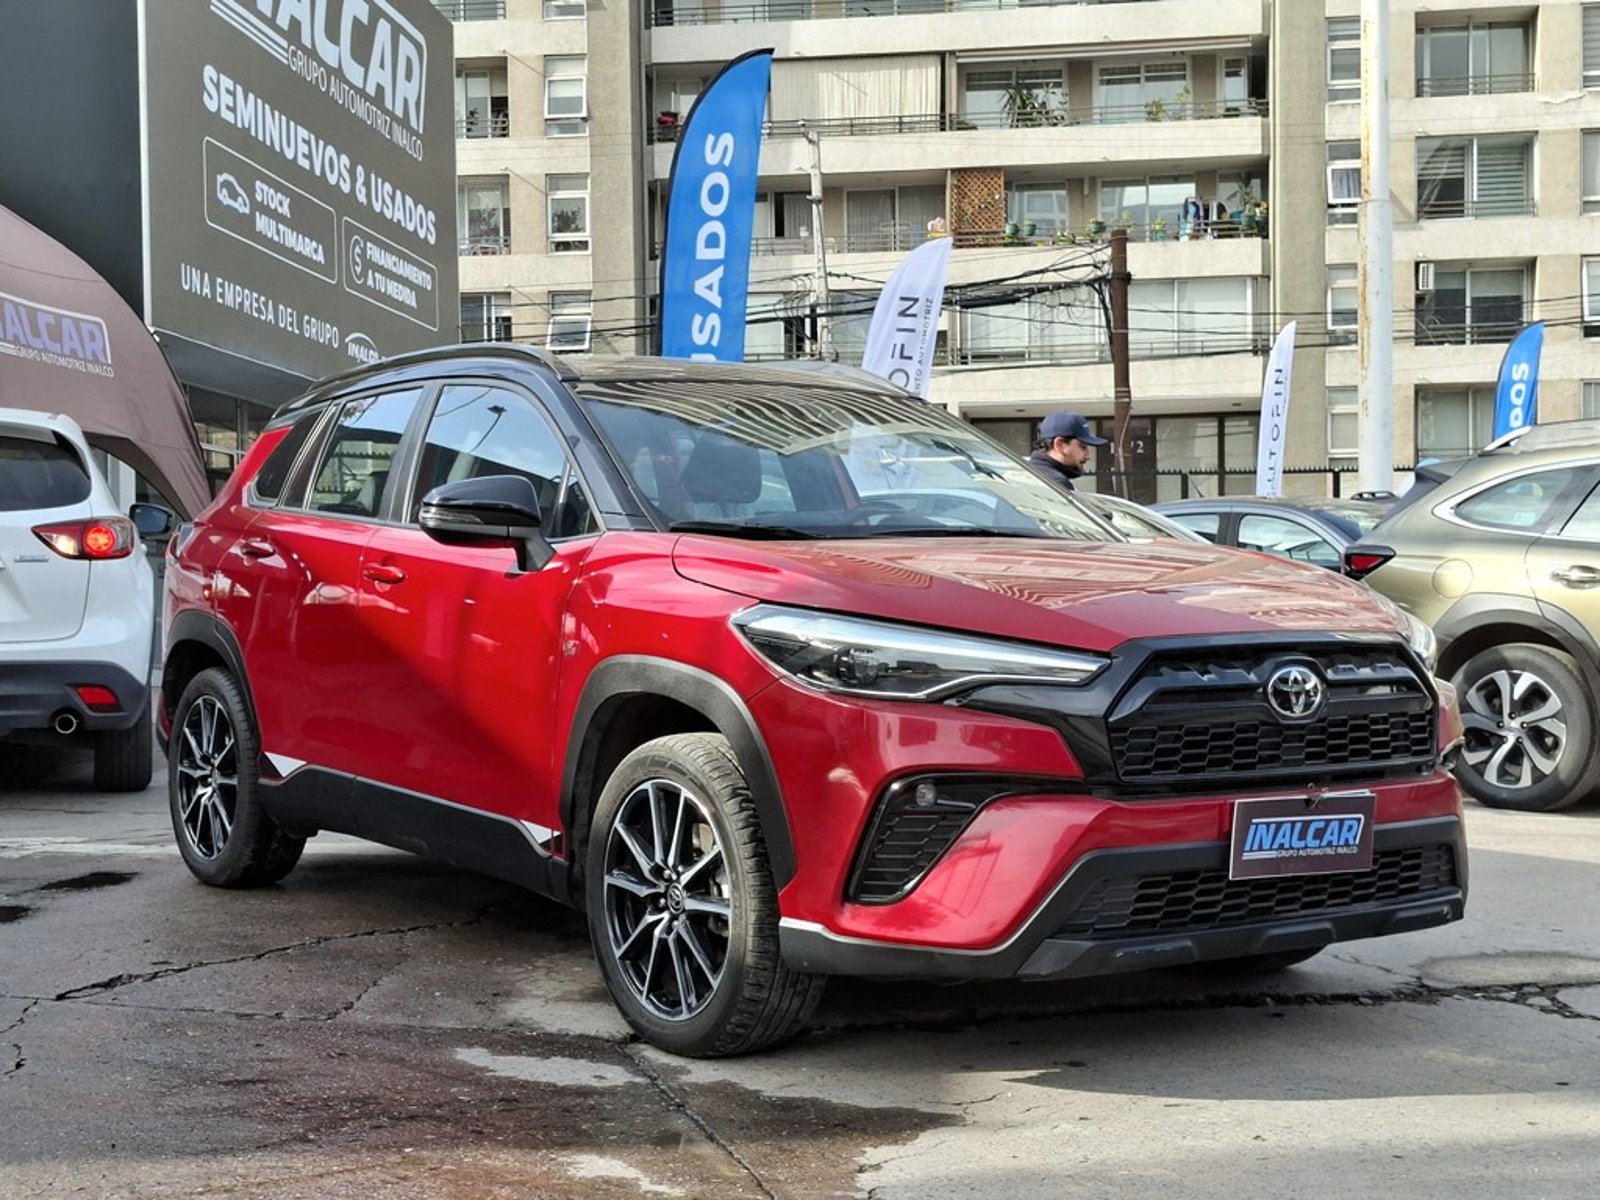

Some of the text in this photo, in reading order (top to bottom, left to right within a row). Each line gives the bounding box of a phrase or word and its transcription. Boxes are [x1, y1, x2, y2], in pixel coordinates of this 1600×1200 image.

[288, 46, 423, 162] GRUPO AUTOMOTRIZ INALCO
[203, 64, 437, 246] SEMINUEVOS & USADOS
[255, 180, 291, 218] STOCK
[255, 211, 325, 264] MULTIMARCA
[366, 241, 432, 291] FINANCIAMIENTO
[690, 132, 735, 362] SADOS
[0, 300, 108, 364] ALCAR
[181, 263, 340, 349] UNA EMPRESA DEL GRUPO
[1244, 819, 1359, 851] INALCAR
